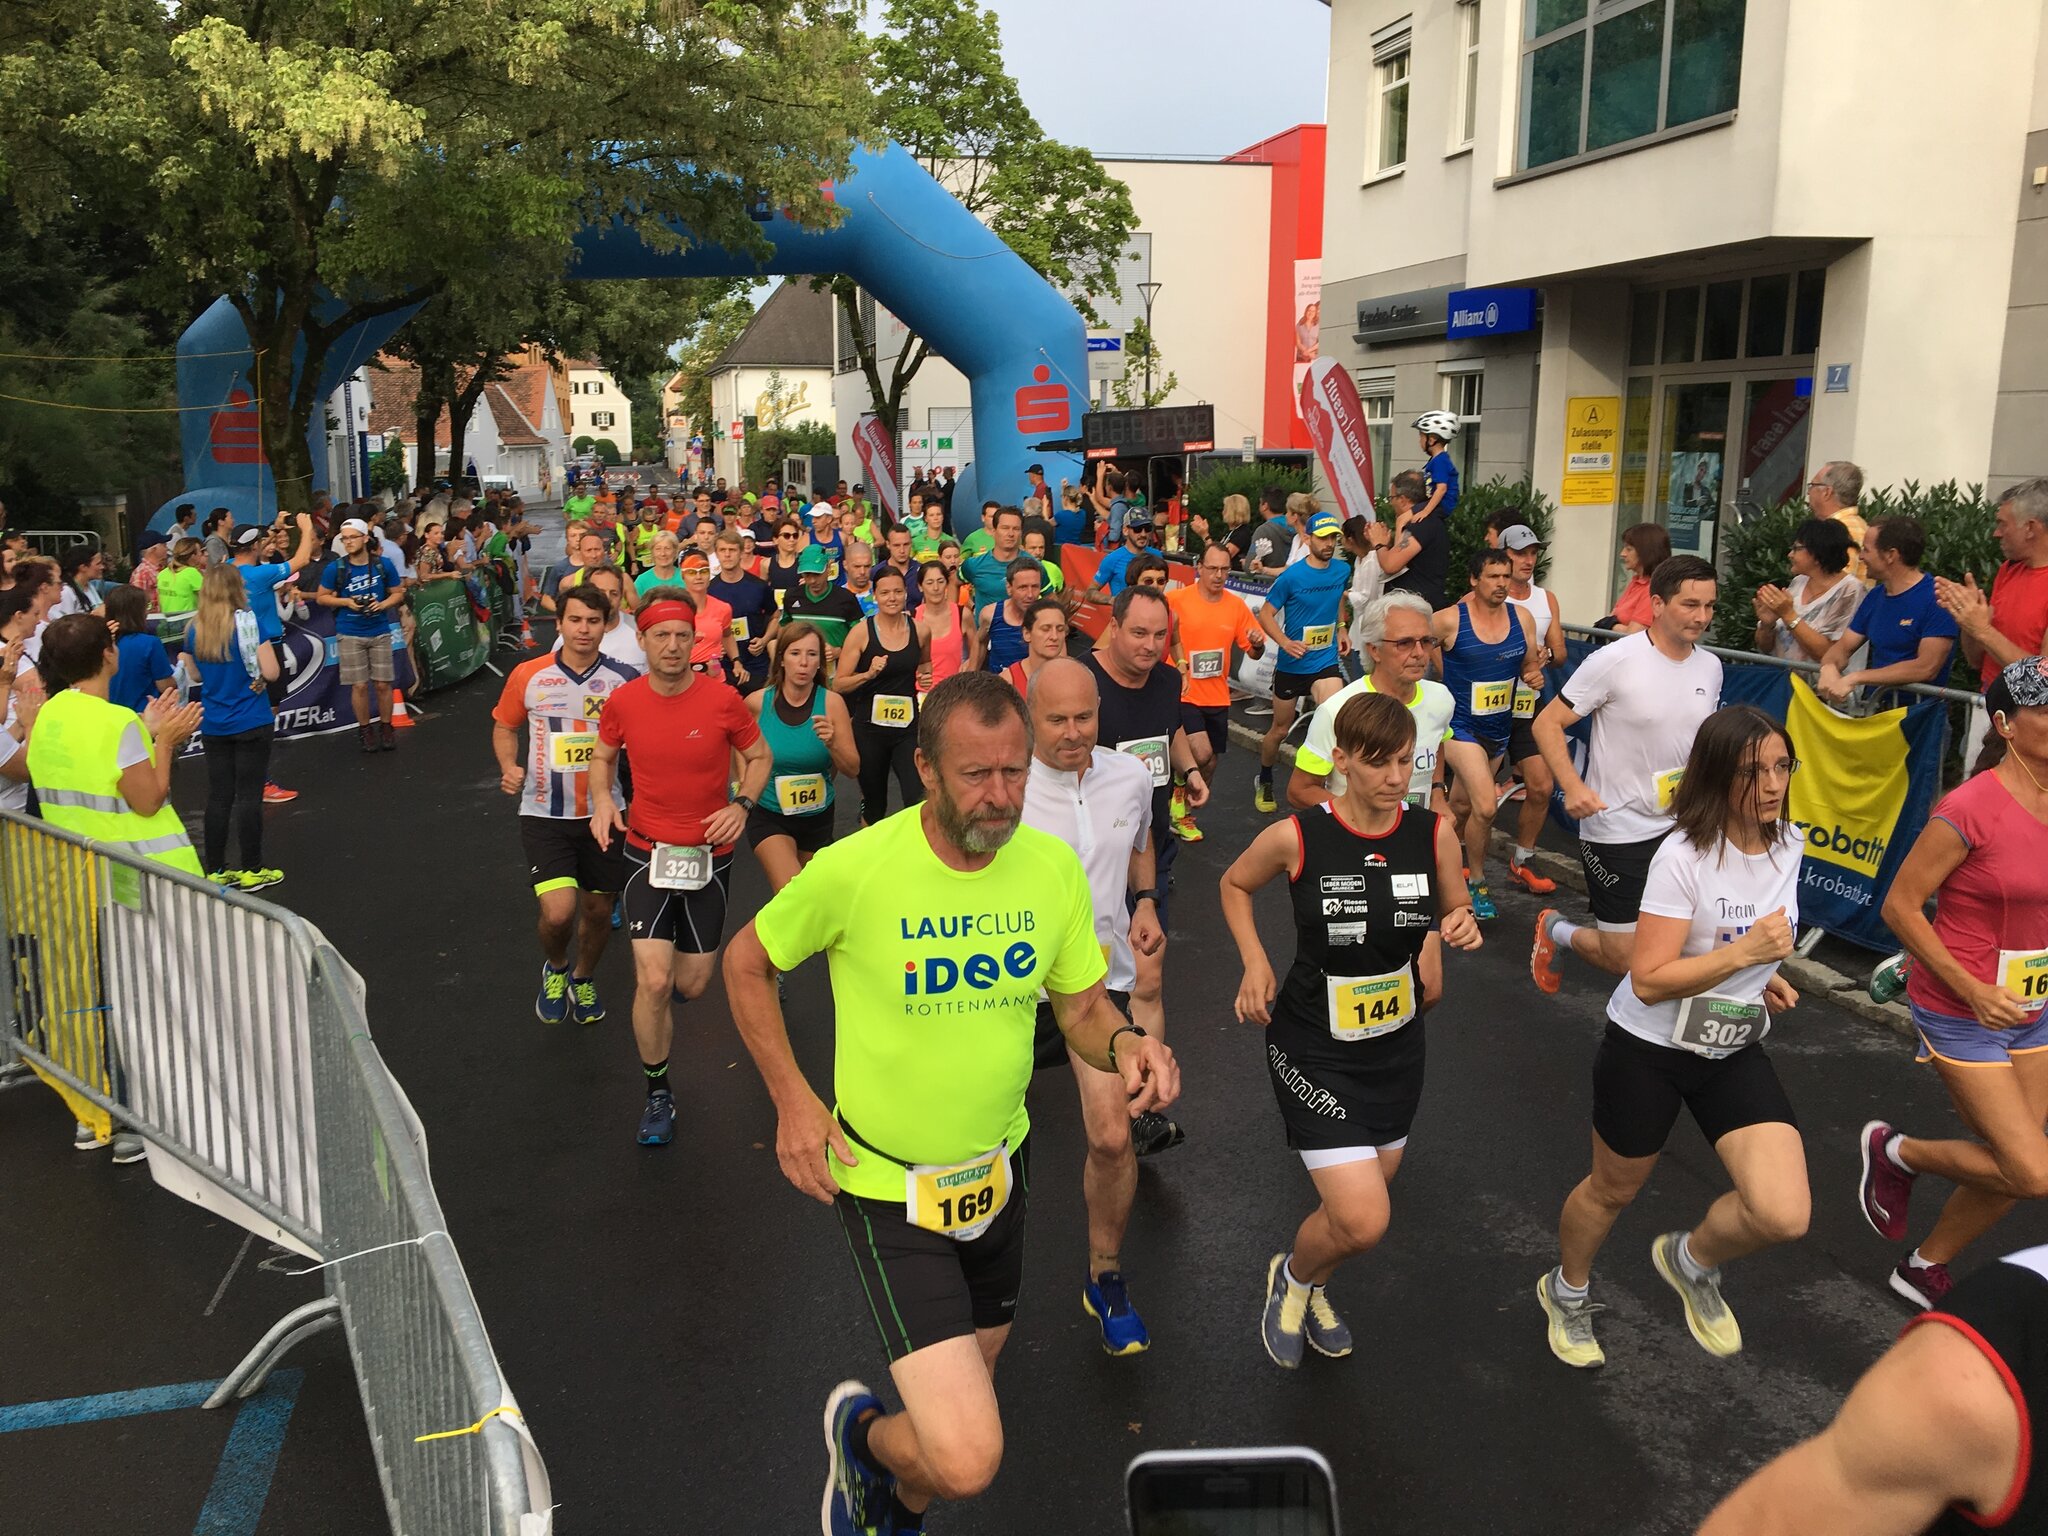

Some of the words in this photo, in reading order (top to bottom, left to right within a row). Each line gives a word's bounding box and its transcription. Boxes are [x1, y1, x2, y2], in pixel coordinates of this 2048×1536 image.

[1452, 310, 1484, 328] Allianz
[1834, 367, 1842, 382] 7
[1587, 407, 1599, 423] A
[1571, 427, 1616, 439] Zulassungs-
[1581, 441, 1602, 450] stelle
[1571, 456, 1598, 464] Allianz
[1311, 634, 1328, 646] 154
[1199, 660, 1219, 672] 327
[1484, 694, 1506, 707] 141
[883, 707, 905, 719] 162
[565, 748, 593, 763] 128
[790, 789, 817, 805] 164
[665, 860, 700, 879] 320
[1344, 906, 1368, 914] WURM
[1715, 897, 1757, 920] Team
[901, 911, 1036, 940] LAUFCLUB
[1353, 995, 1400, 1024] 144
[1700, 1020, 1752, 1045] 302
[938, 1185, 994, 1227] 169
